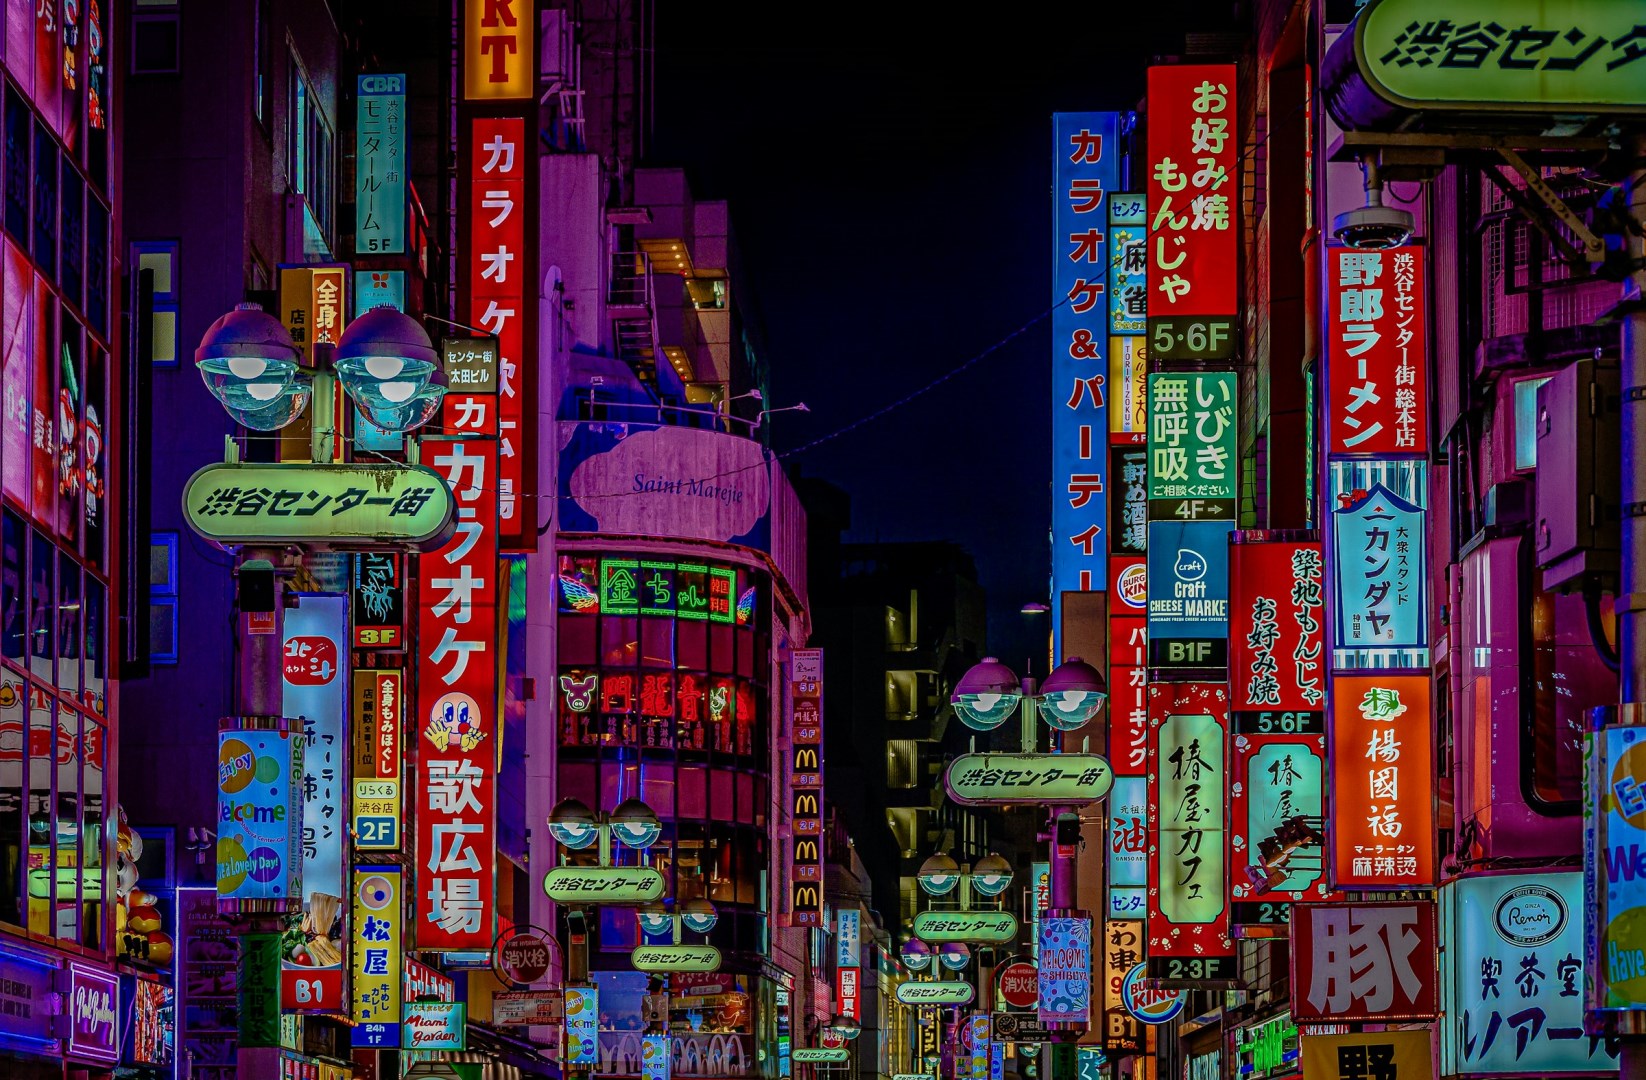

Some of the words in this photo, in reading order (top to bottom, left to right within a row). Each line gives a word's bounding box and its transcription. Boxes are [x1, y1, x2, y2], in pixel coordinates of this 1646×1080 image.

[361, 77, 400, 92] CBR
[386, 100, 399, 183] 渋谷センター街
[362, 101, 381, 230] モニタールーム
[1191, 81, 1229, 230] お好み焼
[1112, 202, 1145, 217] センター
[1152, 157, 1191, 304] もんじゃ
[369, 238, 391, 250] 5F
[448, 351, 492, 363] センター街
[1340, 253, 1383, 448] 野郎ラーメン
[1393, 253, 1415, 447] 渋谷センター街総本店
[451, 369, 489, 383] 太田ビル
[1153, 377, 1189, 481] 無呼吸
[1195, 377, 1233, 480] いびき
[633, 474, 683, 495] Saint
[1153, 485, 1229, 496] ご相談ください
[198, 487, 435, 516] 渋谷センター街
[1175, 500, 1205, 519] 4F
[429, 443, 486, 685] カラオケ
[1179, 561, 1202, 570] craft
[1396, 527, 1408, 605] 大衆スタンド
[607, 569, 706, 607] 金ちゃん
[1175, 582, 1206, 598] Craft
[1364, 527, 1391, 635] カンダヤ
[1150, 600, 1182, 612] CHEESE
[360, 629, 395, 643] 3F
[1292, 549, 1322, 705] 築地もんじゃ
[1169, 642, 1212, 662] B1F
[1247, 597, 1280, 705] お好み焼
[286, 665, 306, 673] ホクト
[381, 679, 394, 774] 全身もみほぐし
[219, 752, 252, 786] Enjoy
[290, 735, 304, 785] Safe,
[321, 734, 336, 839] マーラータン
[958, 768, 1104, 787] 渋谷センター街
[1366, 729, 1402, 838] 楊國福
[360, 785, 394, 796] りらくる
[359, 802, 393, 813] 渋谷店
[1168, 739, 1214, 899] 椿屋カフェ
[362, 821, 391, 841] 2F
[427, 758, 484, 934] 歌広場
[1354, 845, 1415, 853] マーラータン
[230, 857, 257, 875] Lovely
[259, 856, 278, 869] Day!
[550, 877, 657, 891] 渋谷センター街
[1112, 896, 1145, 911] センター
[920, 920, 1012, 933] 渋谷センター街
[362, 915, 392, 976] 松屋
[505, 948, 546, 968] 消火栓
[637, 953, 716, 964] 渋谷センター街
[1307, 906, 1422, 1015] 豚
[1049, 972, 1088, 980] SHIBUYA
[1482, 952, 1582, 1000] 喫茶室
[295, 979, 323, 1002] B1
[371, 987, 380, 1014] カレー
[381, 984, 390, 1011] 牛めし
[901, 988, 969, 997] 渋谷センター街
[362, 994, 370, 1018] 定食
[366, 1024, 385, 1032] 24h
[404, 1015, 449, 1027] Miami
[1108, 1014, 1137, 1037] B1
[368, 1035, 382, 1044] 1F
